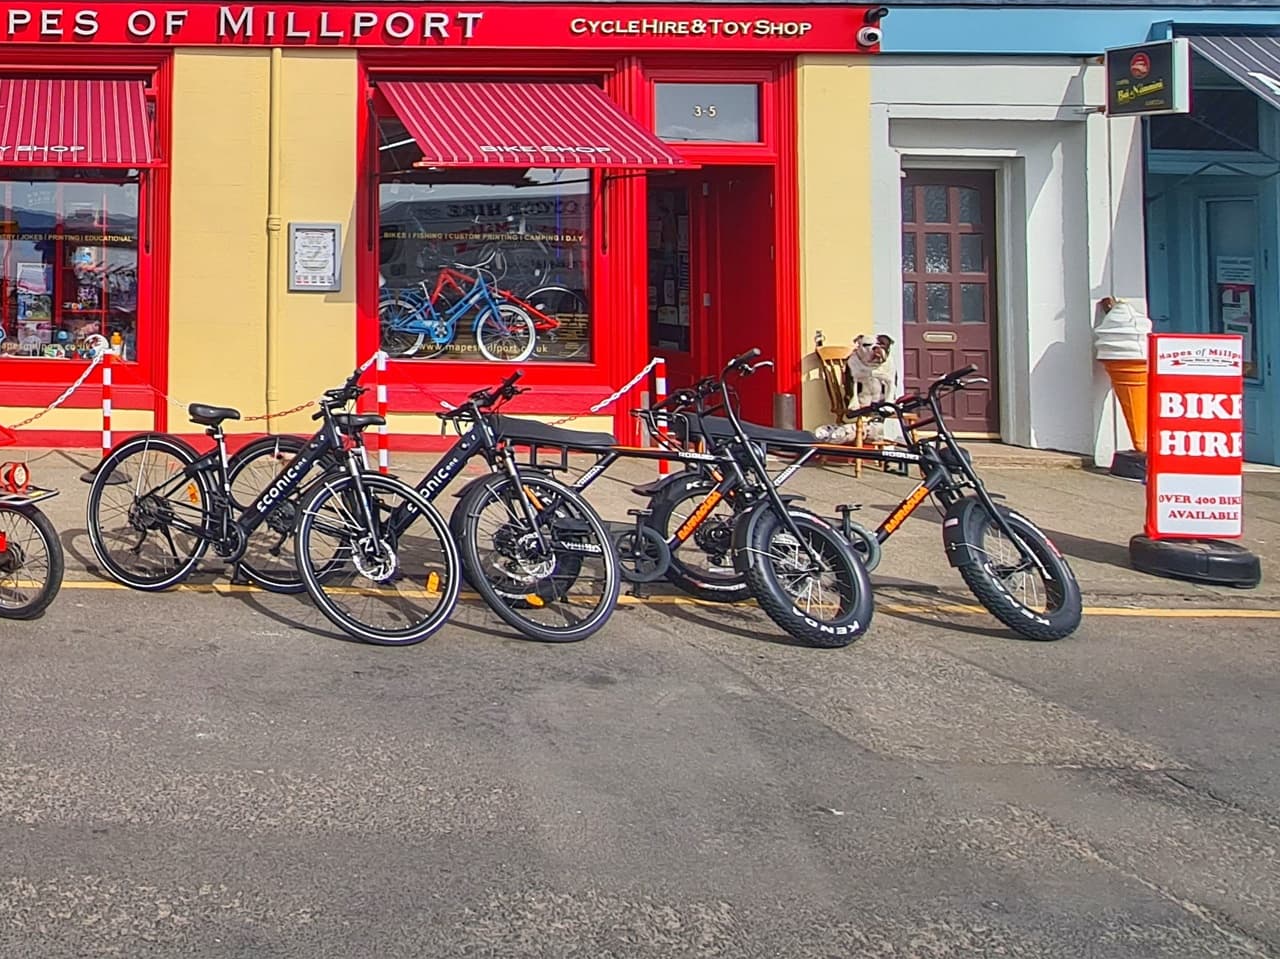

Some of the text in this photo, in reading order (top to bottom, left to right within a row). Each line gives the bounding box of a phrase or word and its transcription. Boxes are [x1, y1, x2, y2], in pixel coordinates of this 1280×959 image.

[127, 10, 189, 36] OF
[218, 6, 483, 38] MILLPORT
[480, 145, 612, 153] BIKE SHOP
[19, 233, 44, 241] JOKES
[84, 234, 133, 242] EDUCATIONAL
[412, 232, 443, 240] FISHING
[447, 233, 481, 241] CUSTOM
[482, 233, 519, 242] PRINTING
[523, 234, 559, 242] CAMPING
[1195, 348, 1206, 357] of
[1158, 494, 1192, 504] OVER
[1195, 496, 1217, 505] 400
